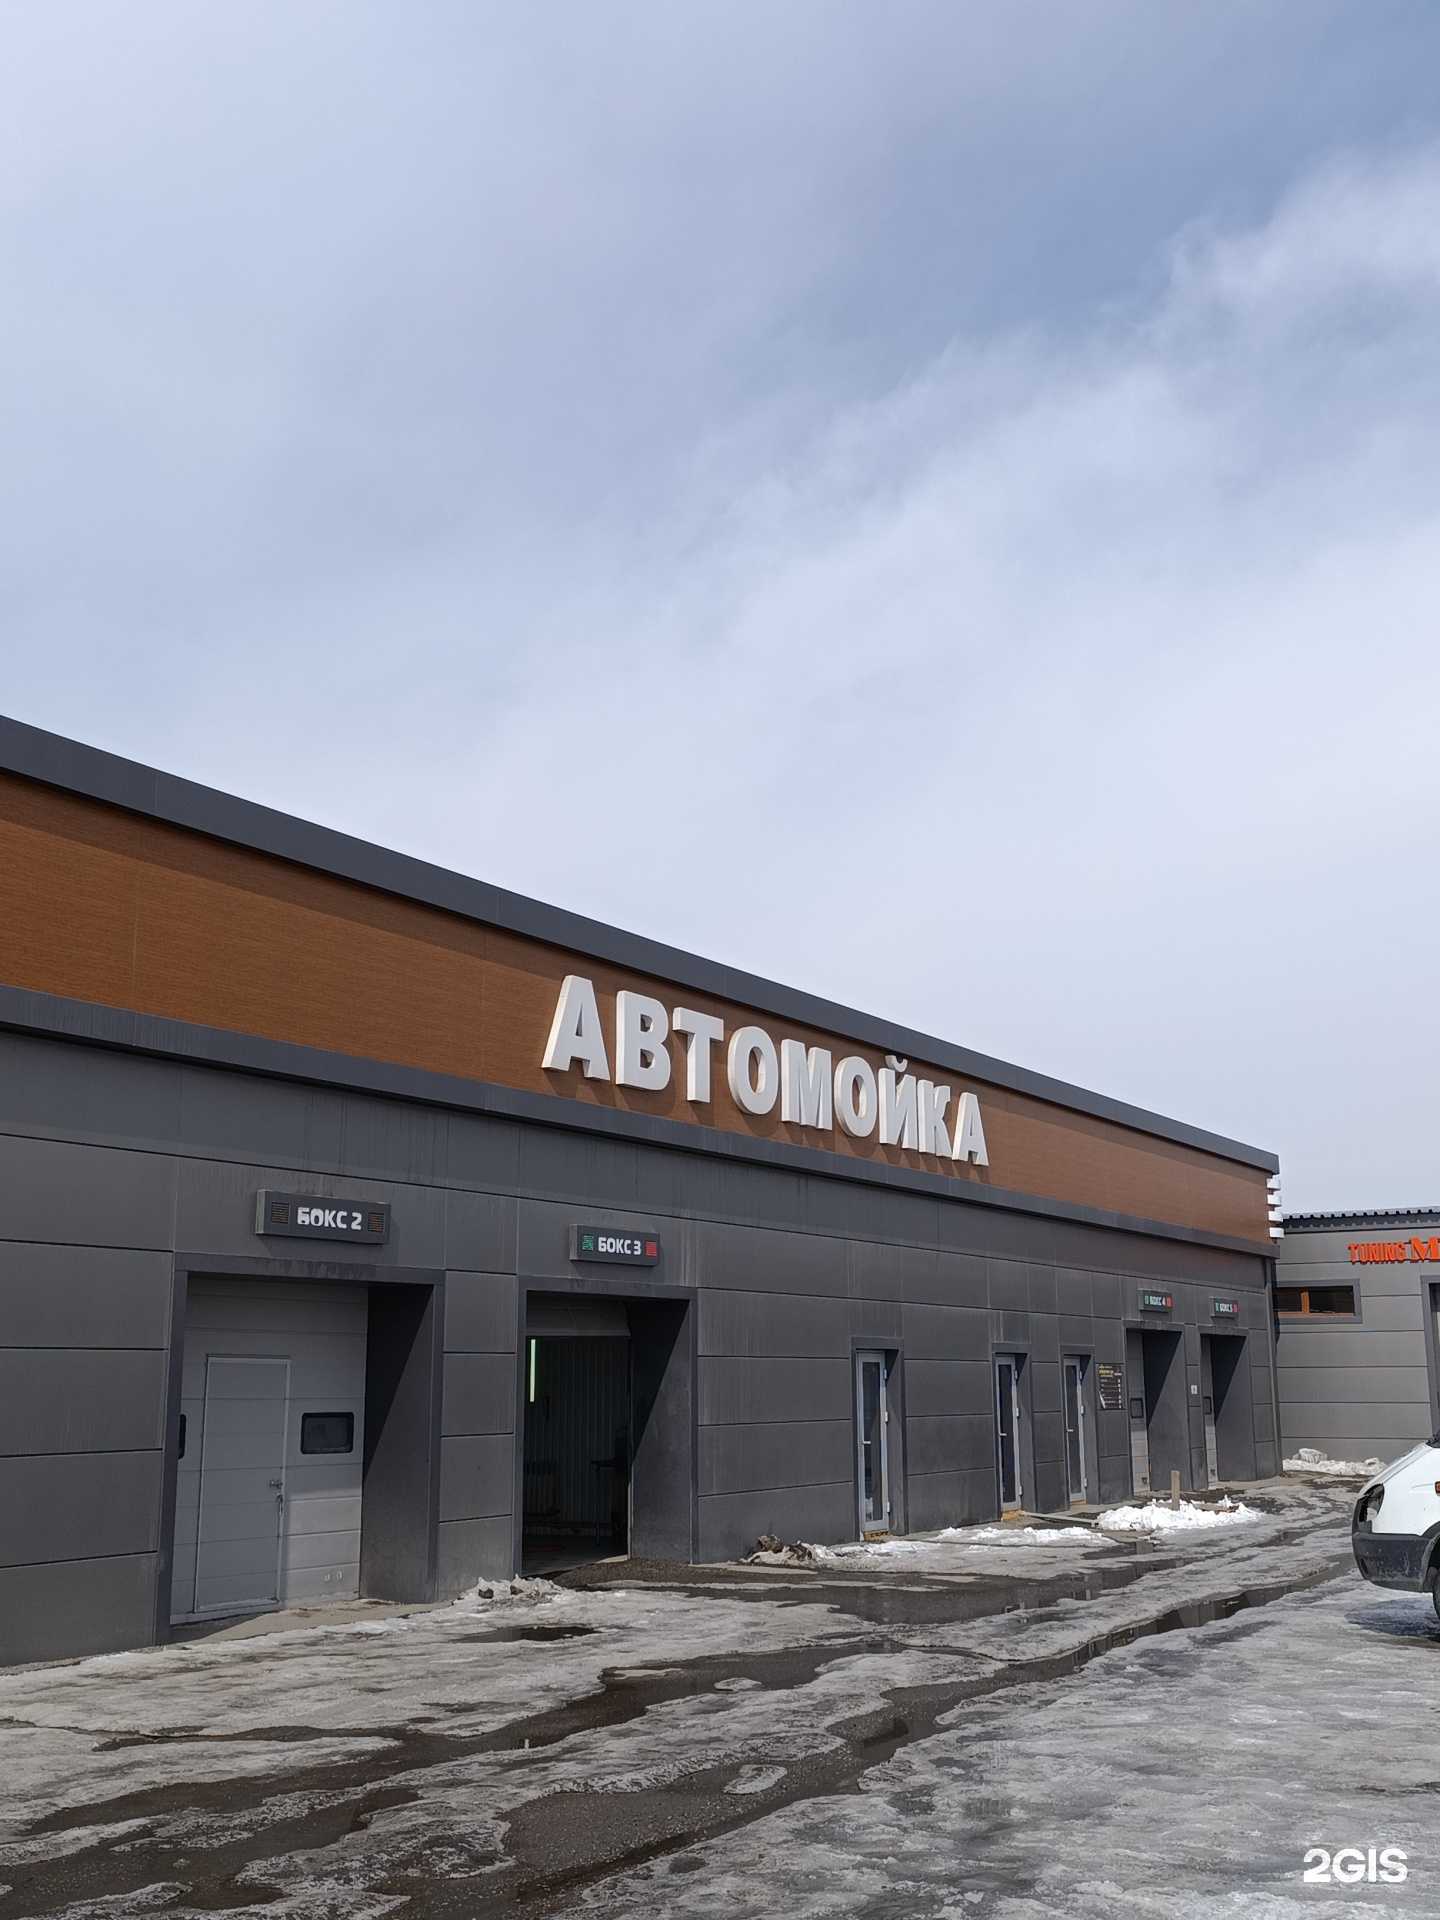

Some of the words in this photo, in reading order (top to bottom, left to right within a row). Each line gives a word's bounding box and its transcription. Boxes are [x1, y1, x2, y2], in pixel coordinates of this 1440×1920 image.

[542, 974, 988, 1166] АВТОМОЙКА
[297, 1207, 348, 1229] БОКС
[350, 1212, 362, 1231] 2
[598, 1236, 632, 1255] БОКС
[633, 1240, 642, 1255] 3
